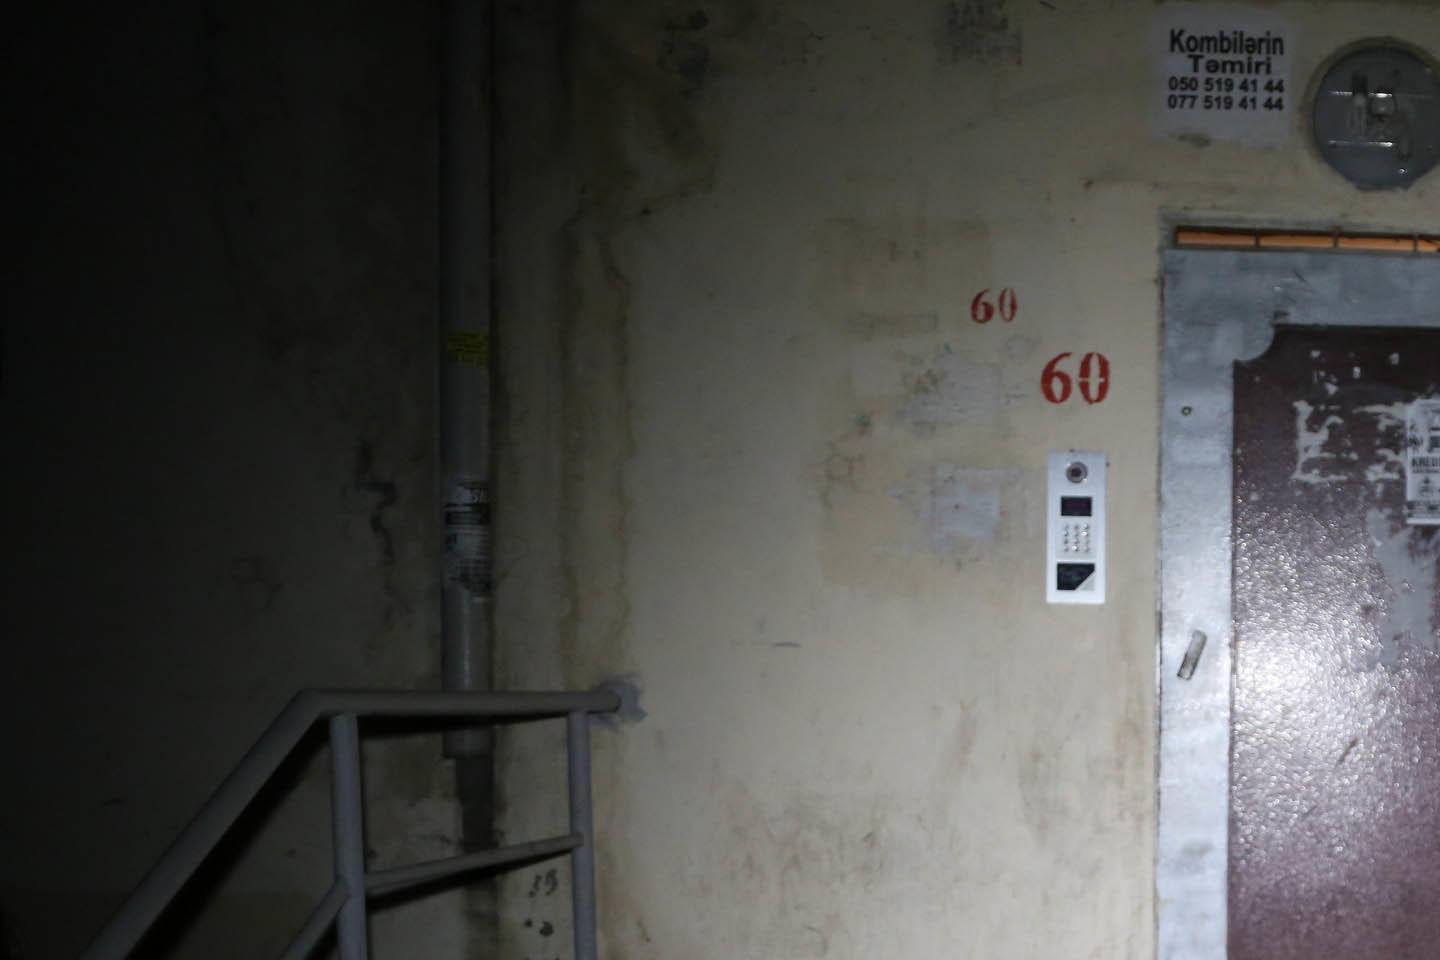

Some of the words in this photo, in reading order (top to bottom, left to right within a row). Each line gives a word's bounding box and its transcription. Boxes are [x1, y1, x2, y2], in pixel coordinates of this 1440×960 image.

[1169, 28, 1285, 55] Kombilərin
[1187, 54, 1273, 75] Təmiri
[1168, 76, 1199, 91] 050
[1203, 77, 1234, 92] 519
[1239, 79, 1258, 92] 41
[1263, 79, 1285, 93] 44
[1167, 94, 1199, 109] 077
[1203, 96, 1234, 110] 519
[1238, 96, 1257, 110] 41
[1263, 97, 1284, 111] 44
[970, 287, 1017, 324] 60
[1041, 352, 1110, 405] 60
